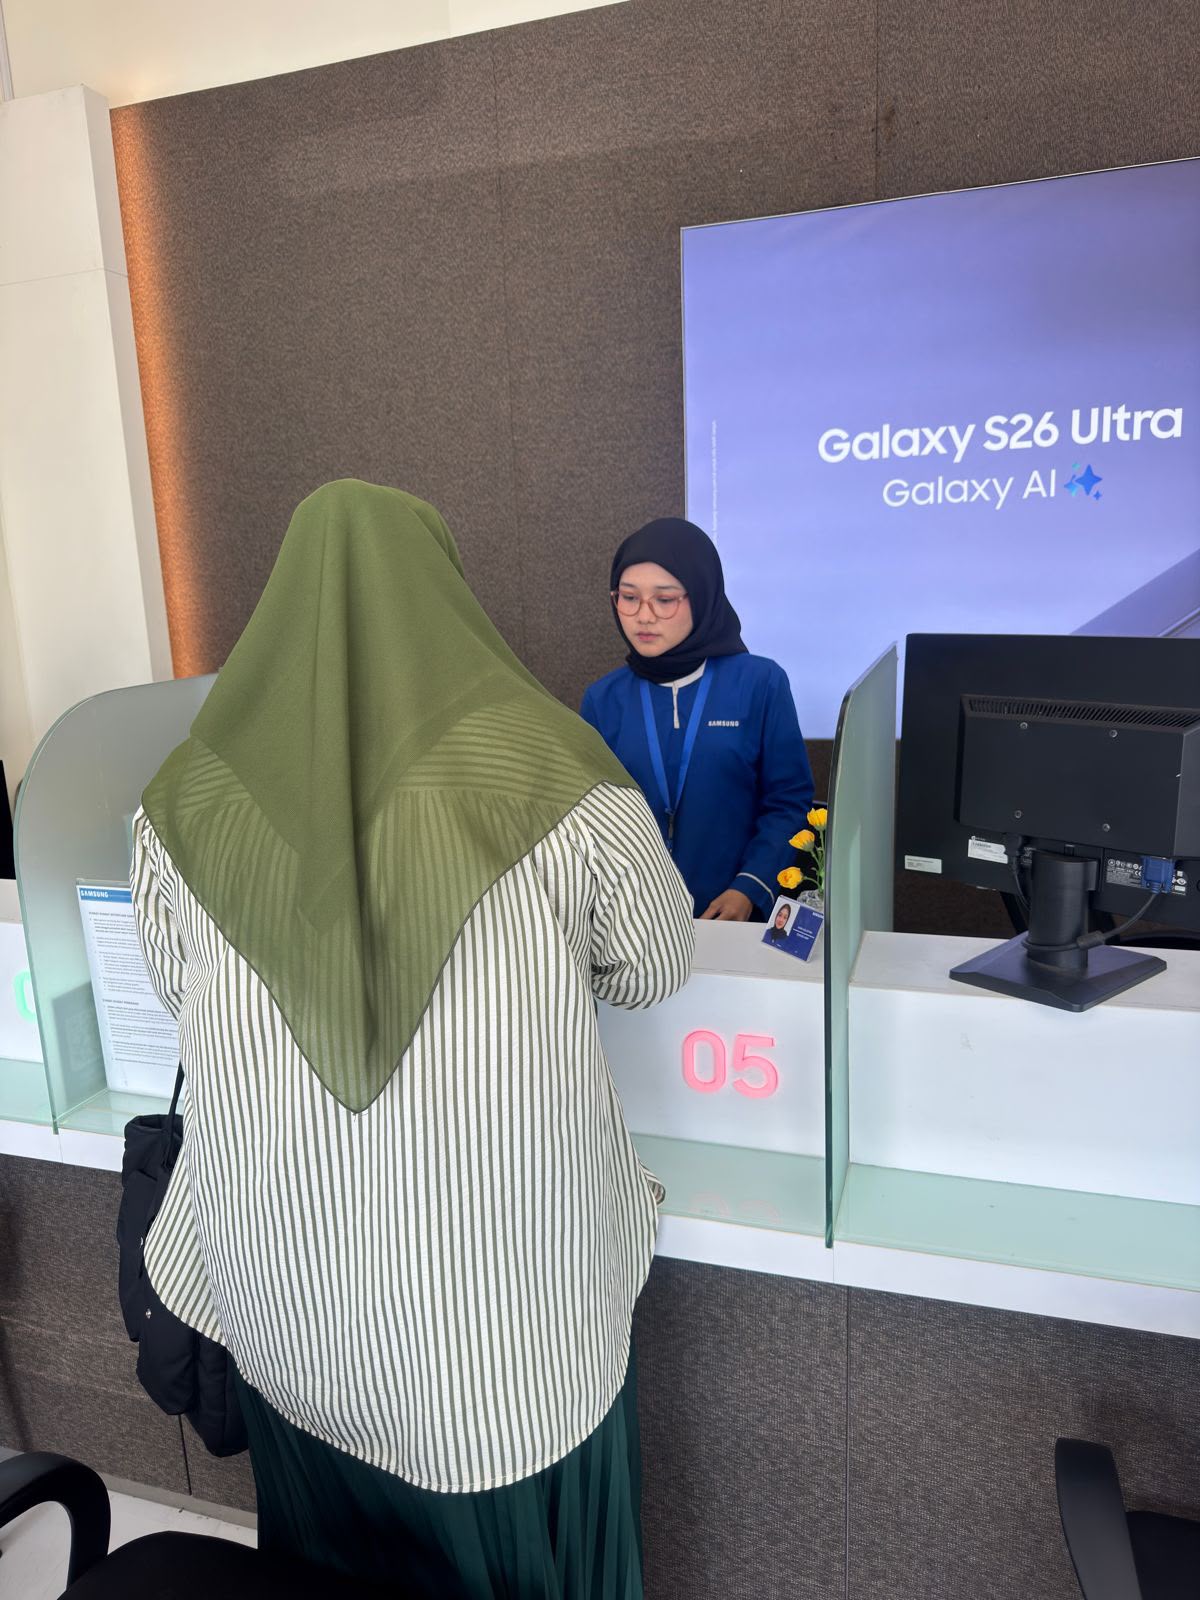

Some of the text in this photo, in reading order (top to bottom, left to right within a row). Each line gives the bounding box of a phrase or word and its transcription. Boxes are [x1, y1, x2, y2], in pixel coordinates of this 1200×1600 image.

[817, 405, 1183, 464] Galaxy S26 Ultra
[882, 468, 1057, 511] Galaxy AI
[80, 889, 109, 898] SAMSUNG
[681, 1029, 779, 1099] 05
